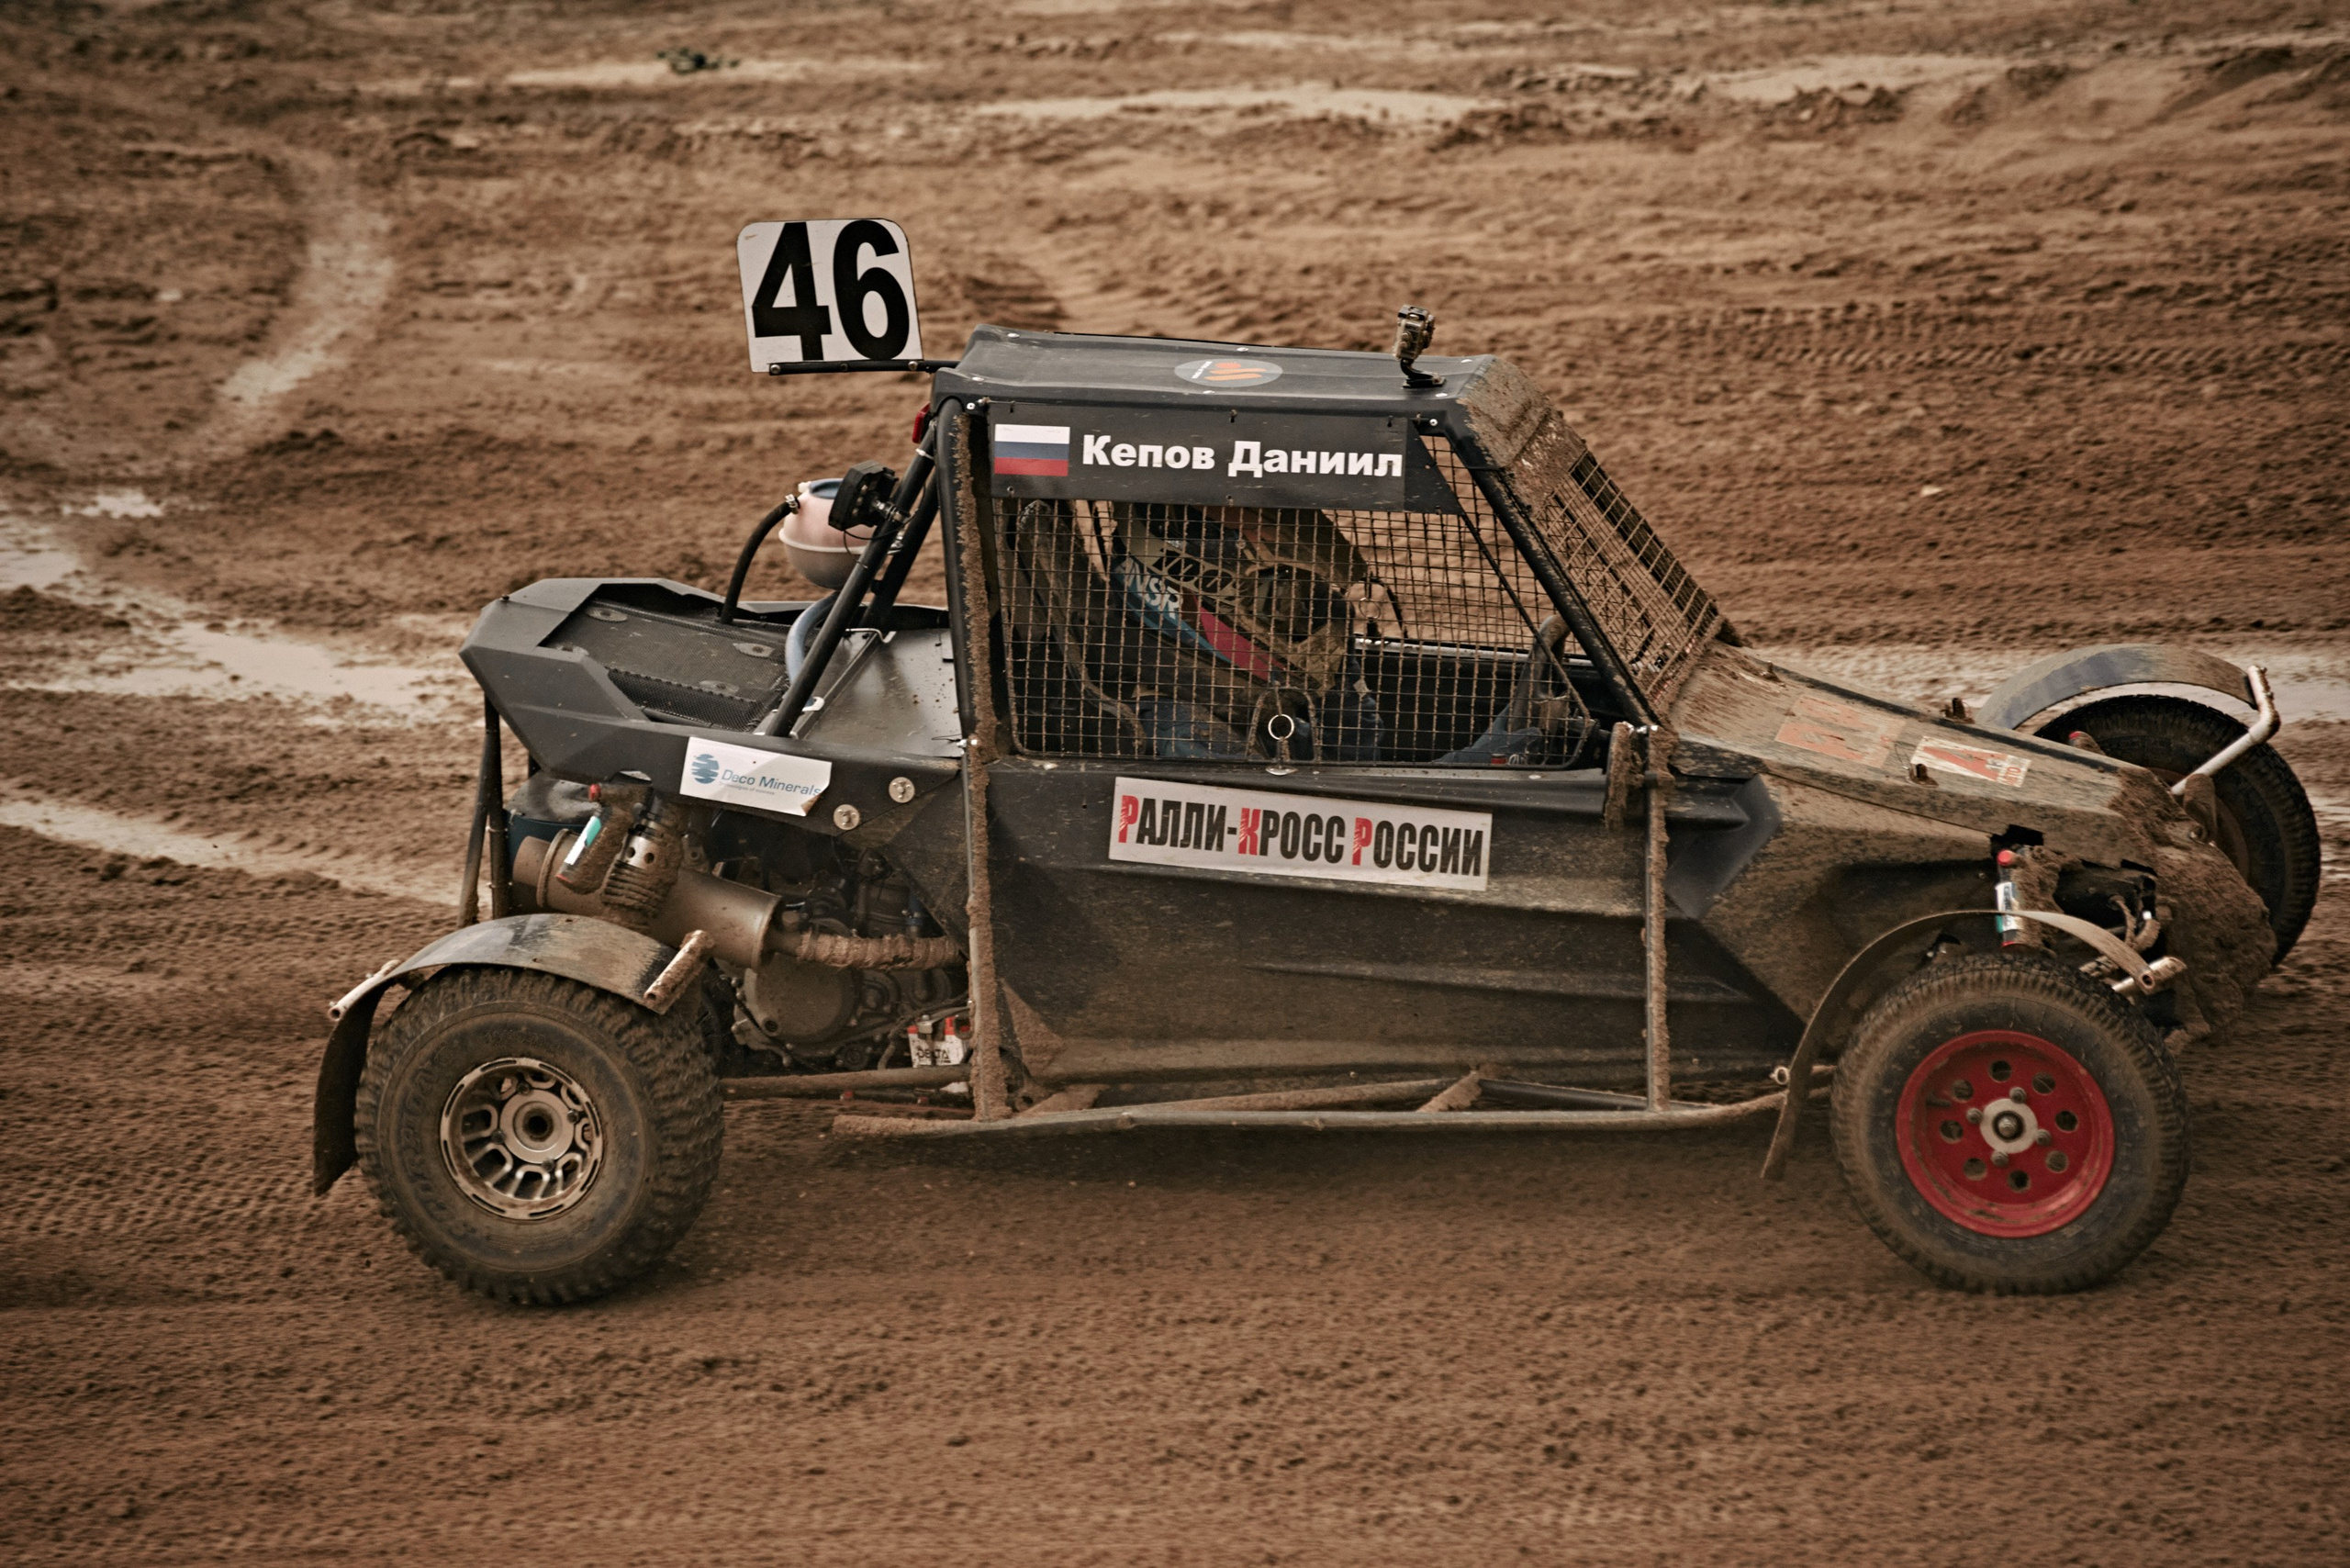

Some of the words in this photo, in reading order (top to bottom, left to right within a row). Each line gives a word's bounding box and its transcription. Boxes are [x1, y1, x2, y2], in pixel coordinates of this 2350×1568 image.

[752, 219, 909, 361] 46
[1082, 434, 1214, 469] Кепов
[1228, 441, 1403, 477] Даниил
[722, 769, 755, 786] Deco
[758, 776, 821, 796] Minerals
[1118, 795, 1346, 863] РАЛЛИ-КРОСС
[1352, 817, 1483, 876] РОССИИ
[916, 1048, 949, 1059] DETA
